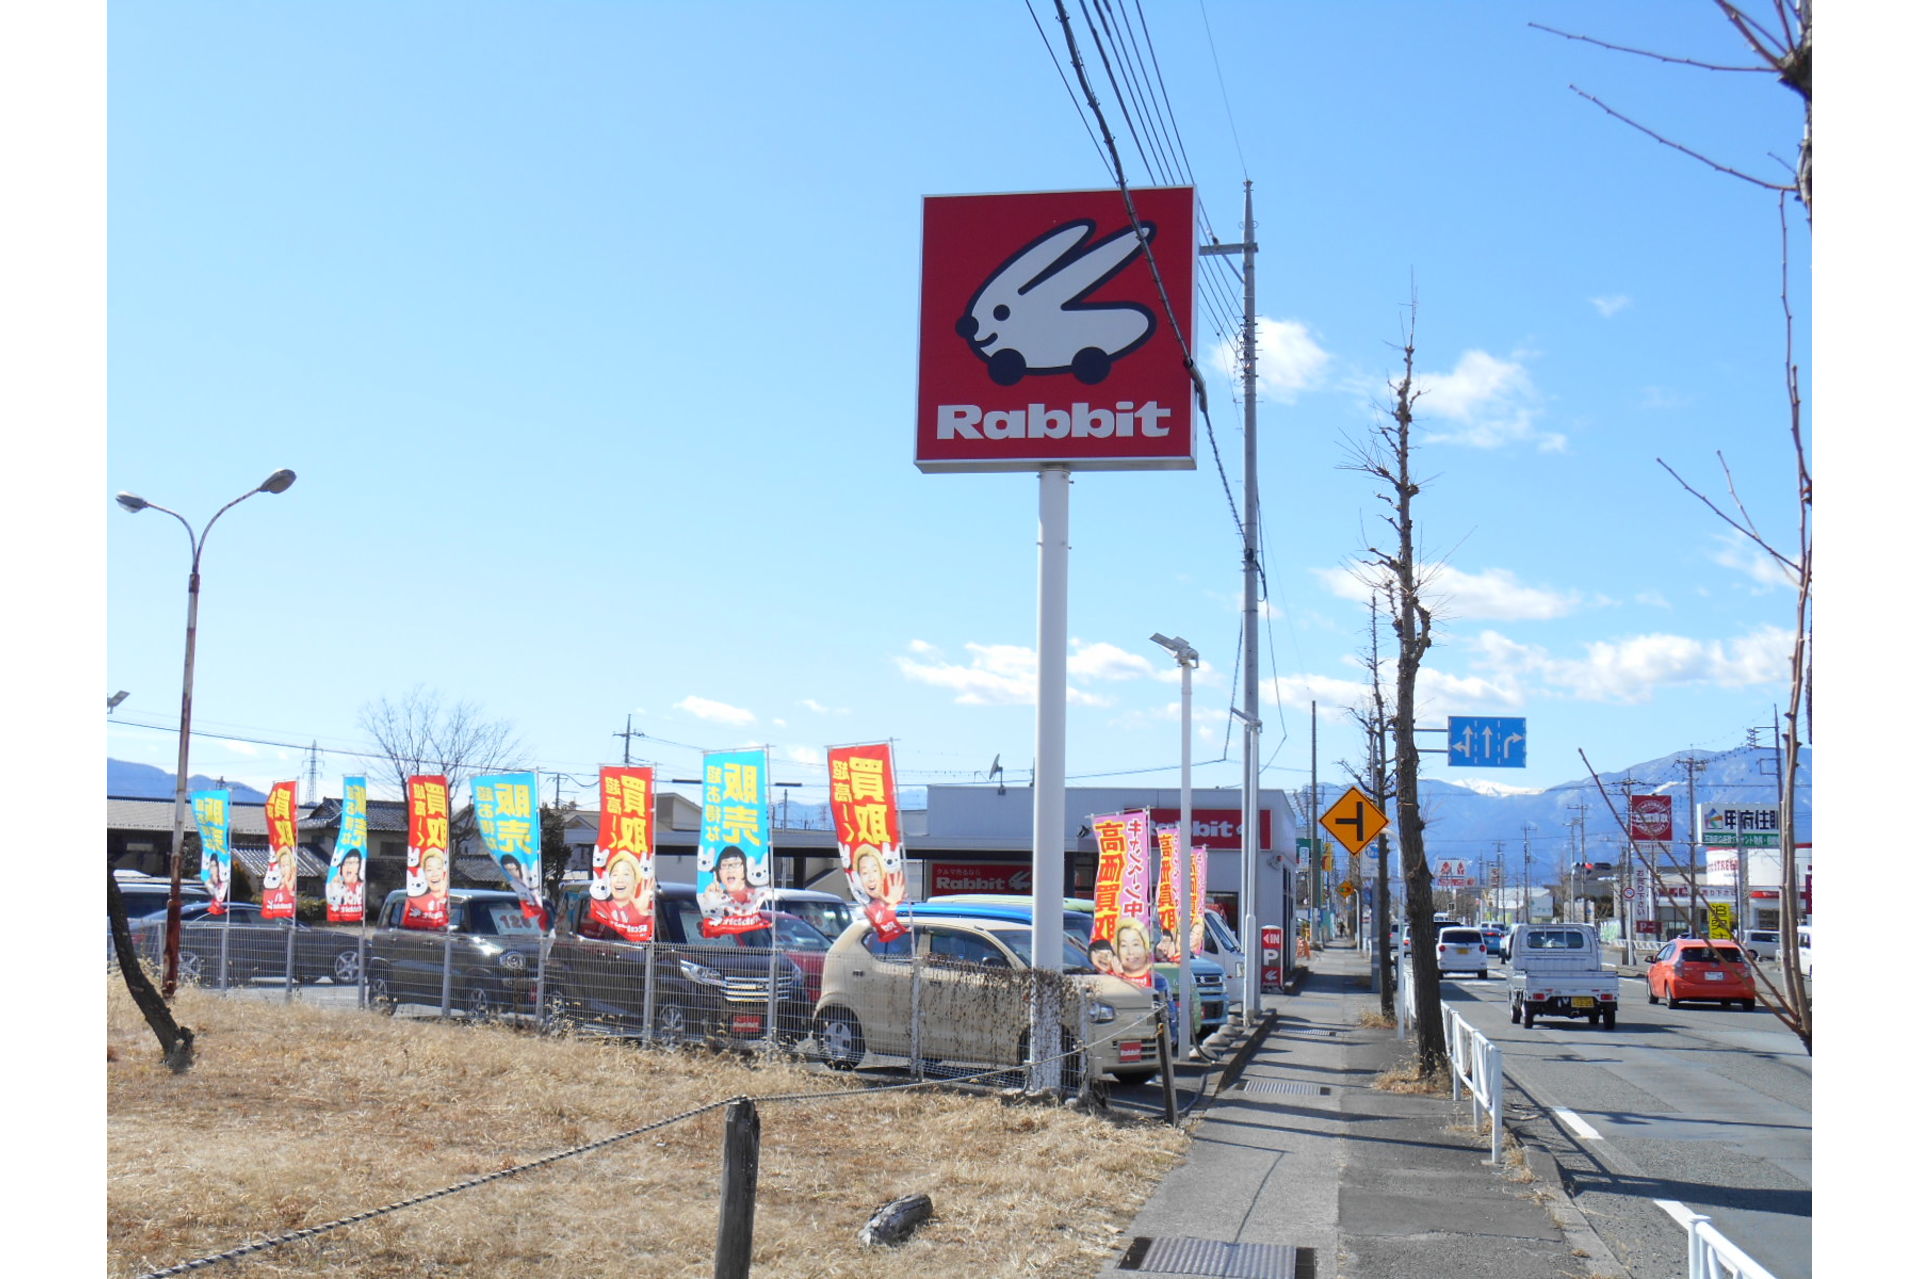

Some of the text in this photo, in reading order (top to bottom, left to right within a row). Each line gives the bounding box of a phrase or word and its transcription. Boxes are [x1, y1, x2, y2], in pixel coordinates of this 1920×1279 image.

[936, 401, 1171, 439] Rabbit
[1149, 820, 1233, 837] Rbit
[1123, 819, 1144, 918] キャンペーン中
[936, 877, 1005, 889] Rabbit
[1094, 821, 1126, 943] 高価買取
[1269, 933, 1280, 944] IN
[1263, 950, 1279, 966] P
